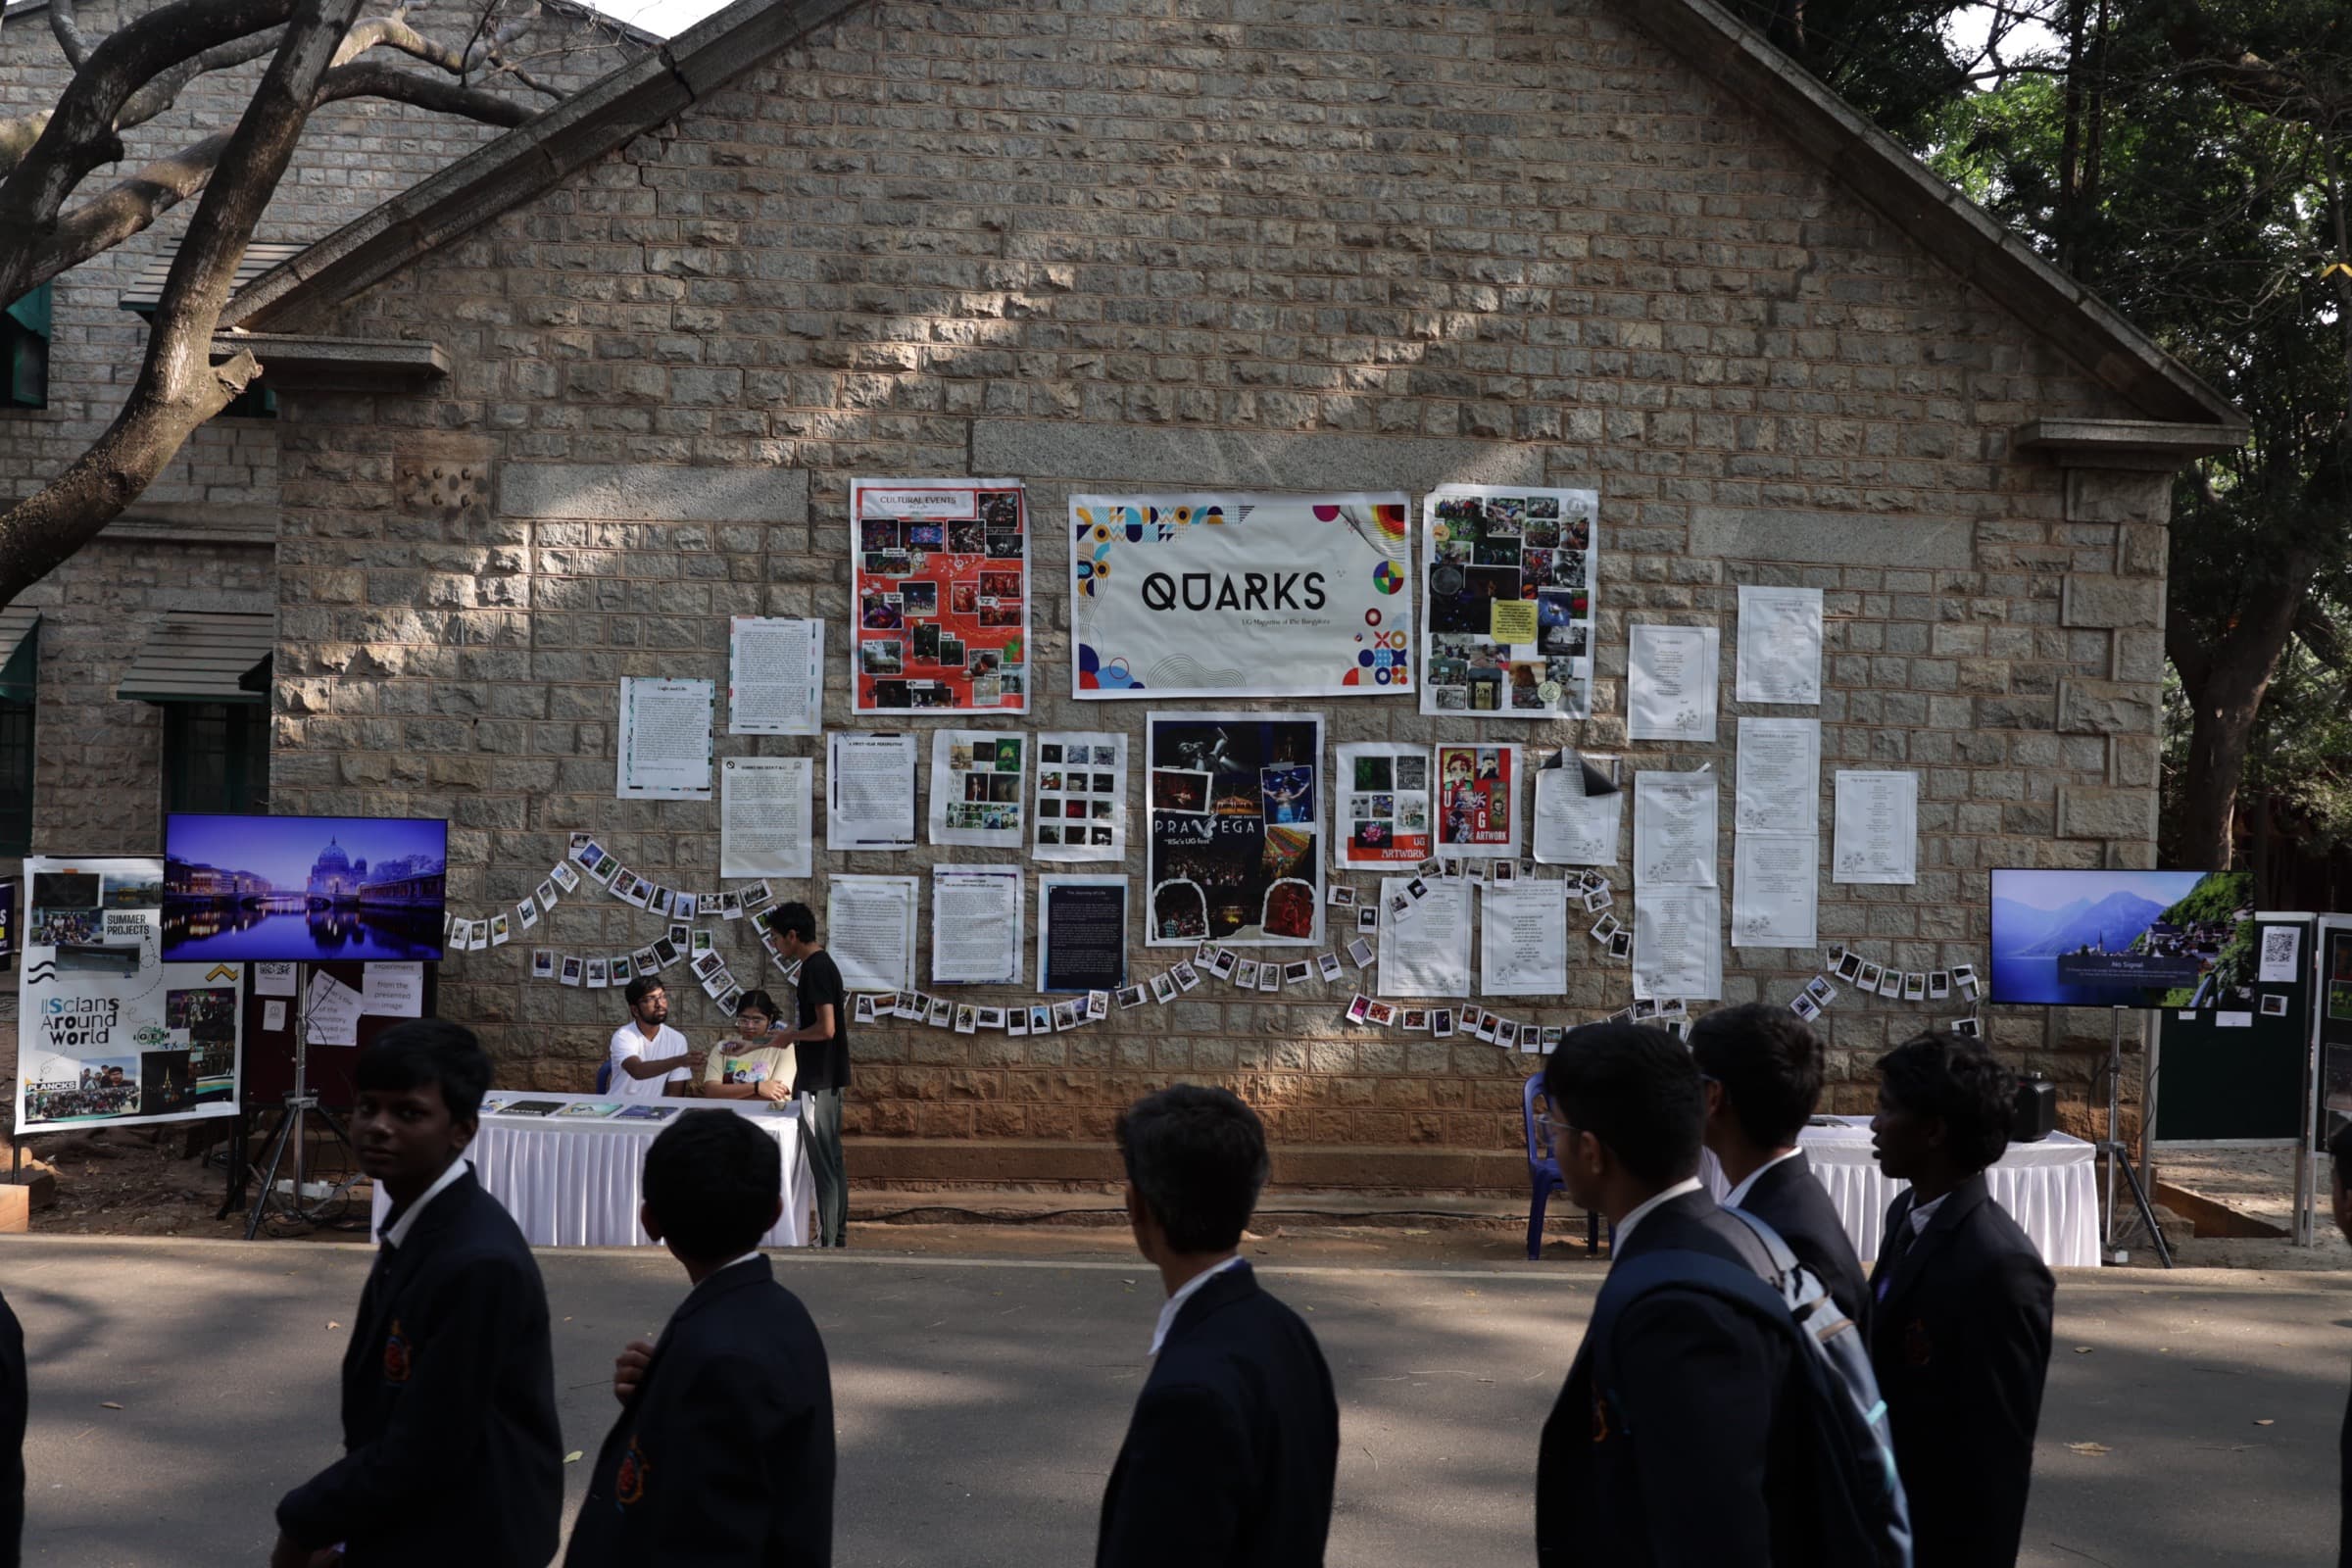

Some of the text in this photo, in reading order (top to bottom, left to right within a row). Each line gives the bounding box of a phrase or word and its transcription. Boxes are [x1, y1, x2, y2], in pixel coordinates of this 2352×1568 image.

[880, 496, 956, 505] CULTURAL EVENTS
[1142, 571, 1326, 611] QUARKS
[1413, 837, 1425, 846] UG
[1476, 831, 1507, 841] ARTWORK
[1381, 849, 1425, 858] ARTWORK
[107, 913, 146, 925] SUMMER
[106, 924, 150, 936] PROJECTS
[40, 997, 120, 1014] IIScians
[40, 1011, 118, 1031] Around
[50, 1028, 109, 1046] world
[27, 1081, 76, 1091] PLANCKS
